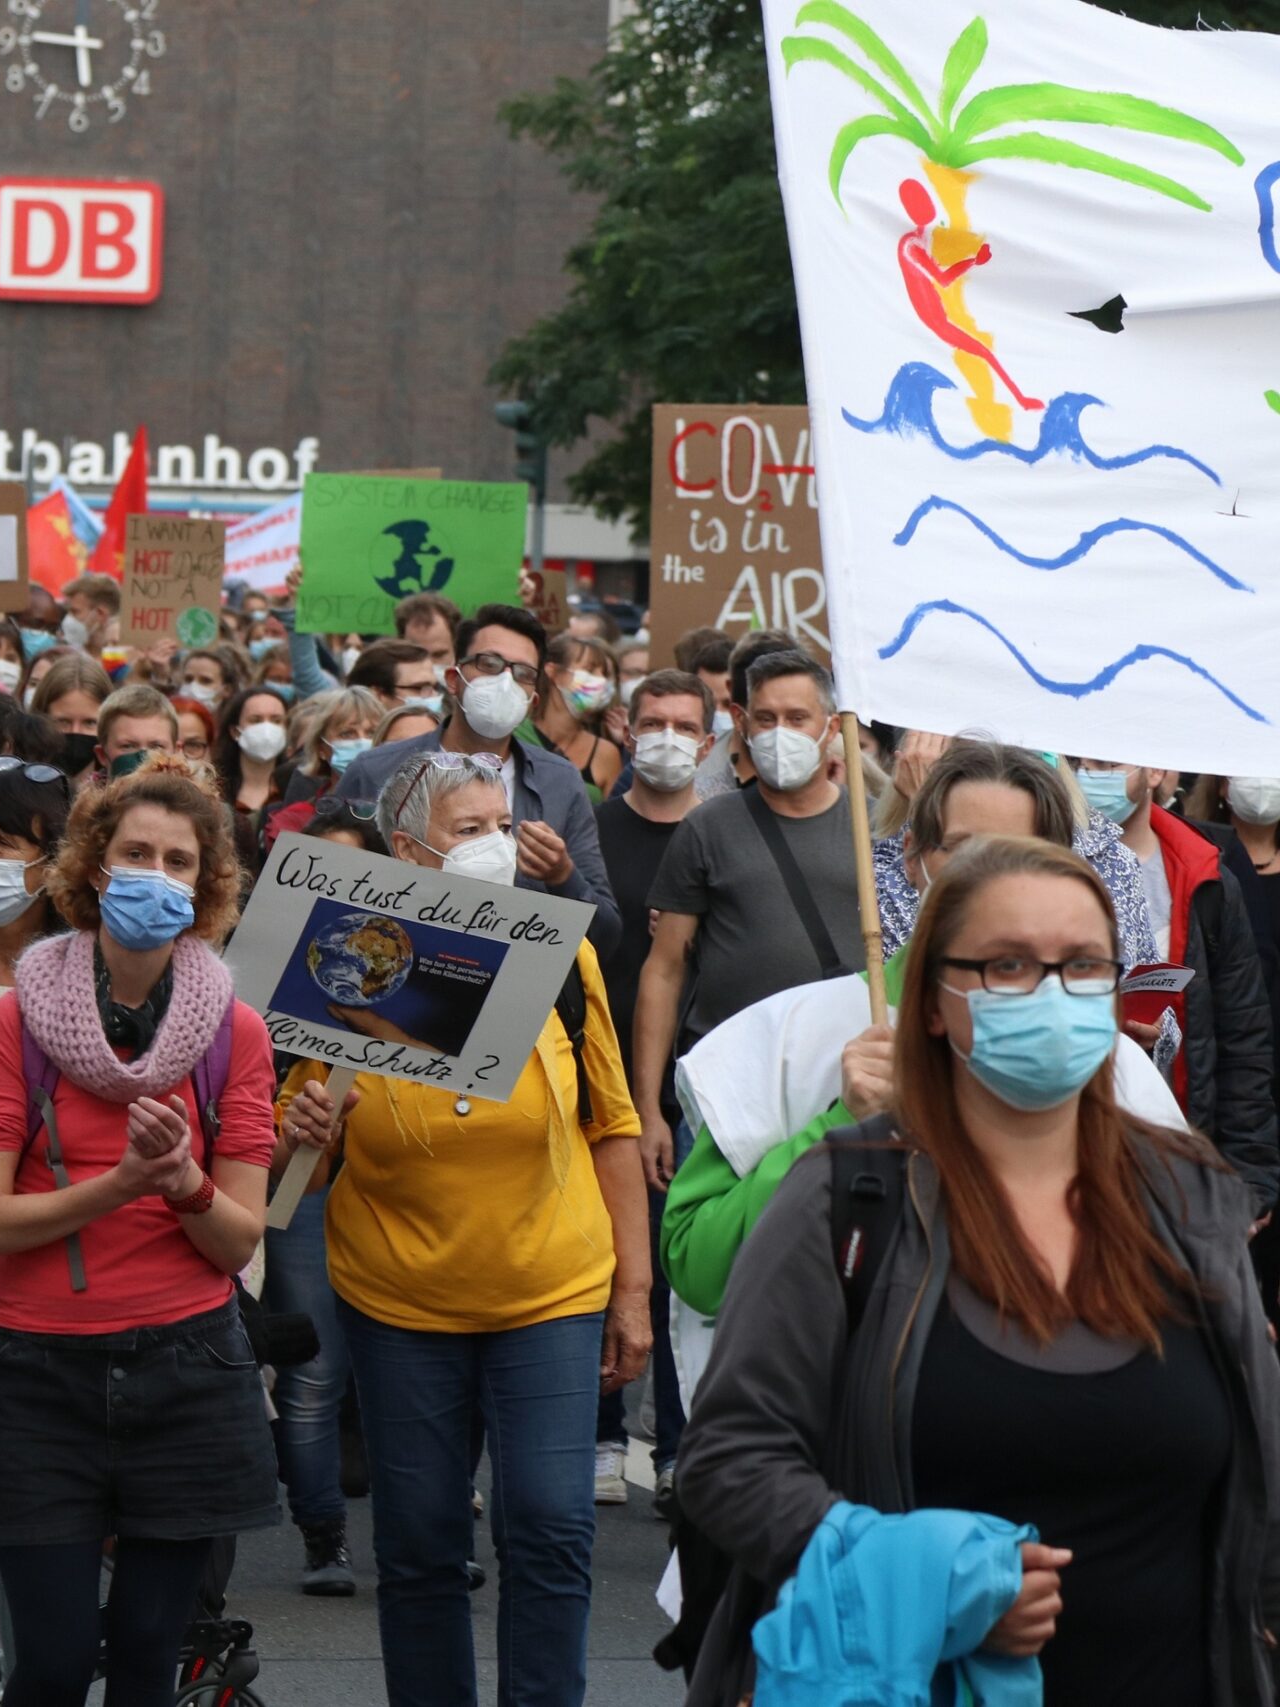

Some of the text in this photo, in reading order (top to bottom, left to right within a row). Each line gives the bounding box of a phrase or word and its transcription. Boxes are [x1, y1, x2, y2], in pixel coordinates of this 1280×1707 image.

[5, 63, 25, 93] 8
[68, 103, 90, 133] 6
[10, 199, 137, 279] DB
[312, 477, 517, 513] SYSTEM CHANGE
[128, 518, 140, 541] I
[146, 521, 195, 542] WANT
[201, 522, 215, 543] A
[689, 509, 791, 553] is in
[132, 549, 174, 576] HOT
[661, 553, 705, 584] the
[131, 578, 197, 601] NOT A
[130, 607, 174, 632] HOT
[299, 594, 358, 626] NOT
[715, 565, 833, 653] AIR
[276, 847, 564, 945] Was tust du für den
